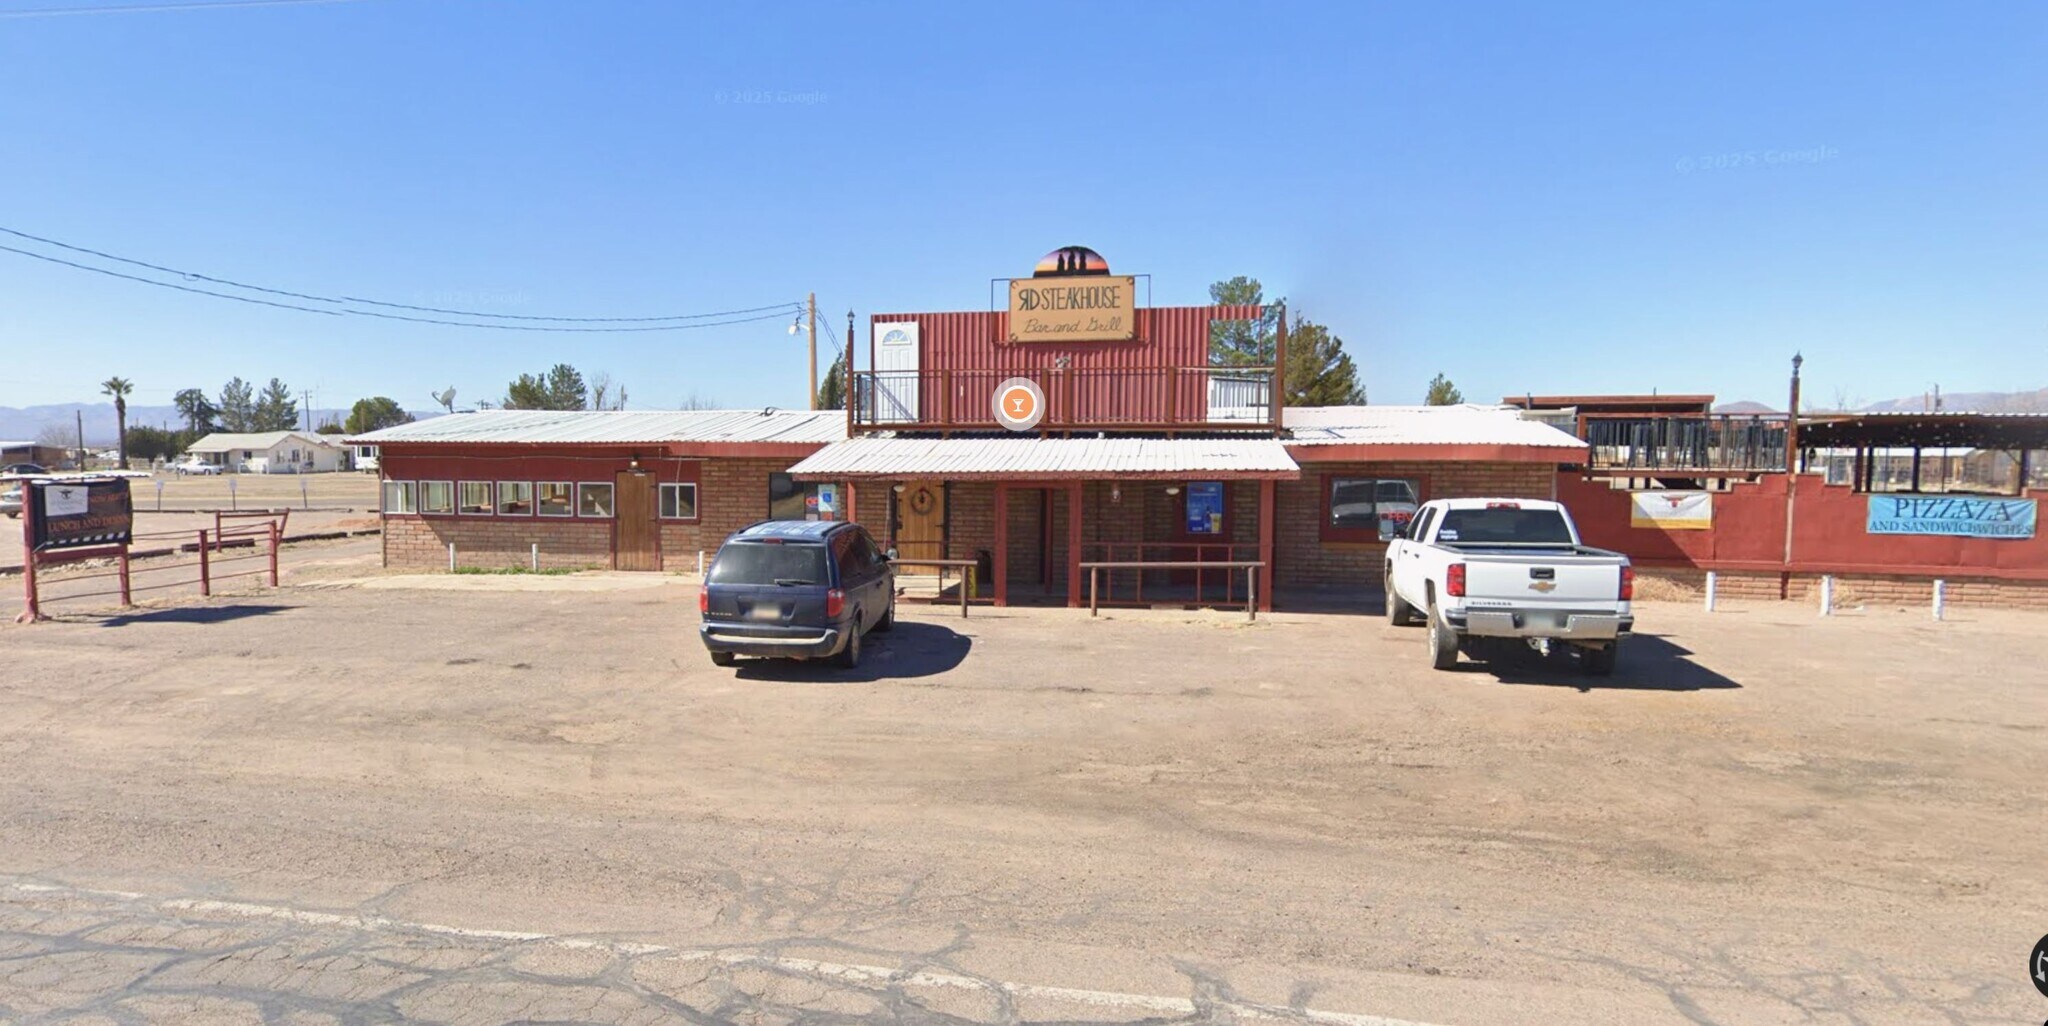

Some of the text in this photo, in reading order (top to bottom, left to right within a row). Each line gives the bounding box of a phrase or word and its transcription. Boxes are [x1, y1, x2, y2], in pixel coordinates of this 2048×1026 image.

[1041, 286, 1120, 310] STEAKHOUSE
[1024, 316, 1122, 333] Bar and Grill
[47, 519, 81, 532] LUNCH
[82, 517, 102, 529] AND
[1869, 520, 1899, 532] AND
